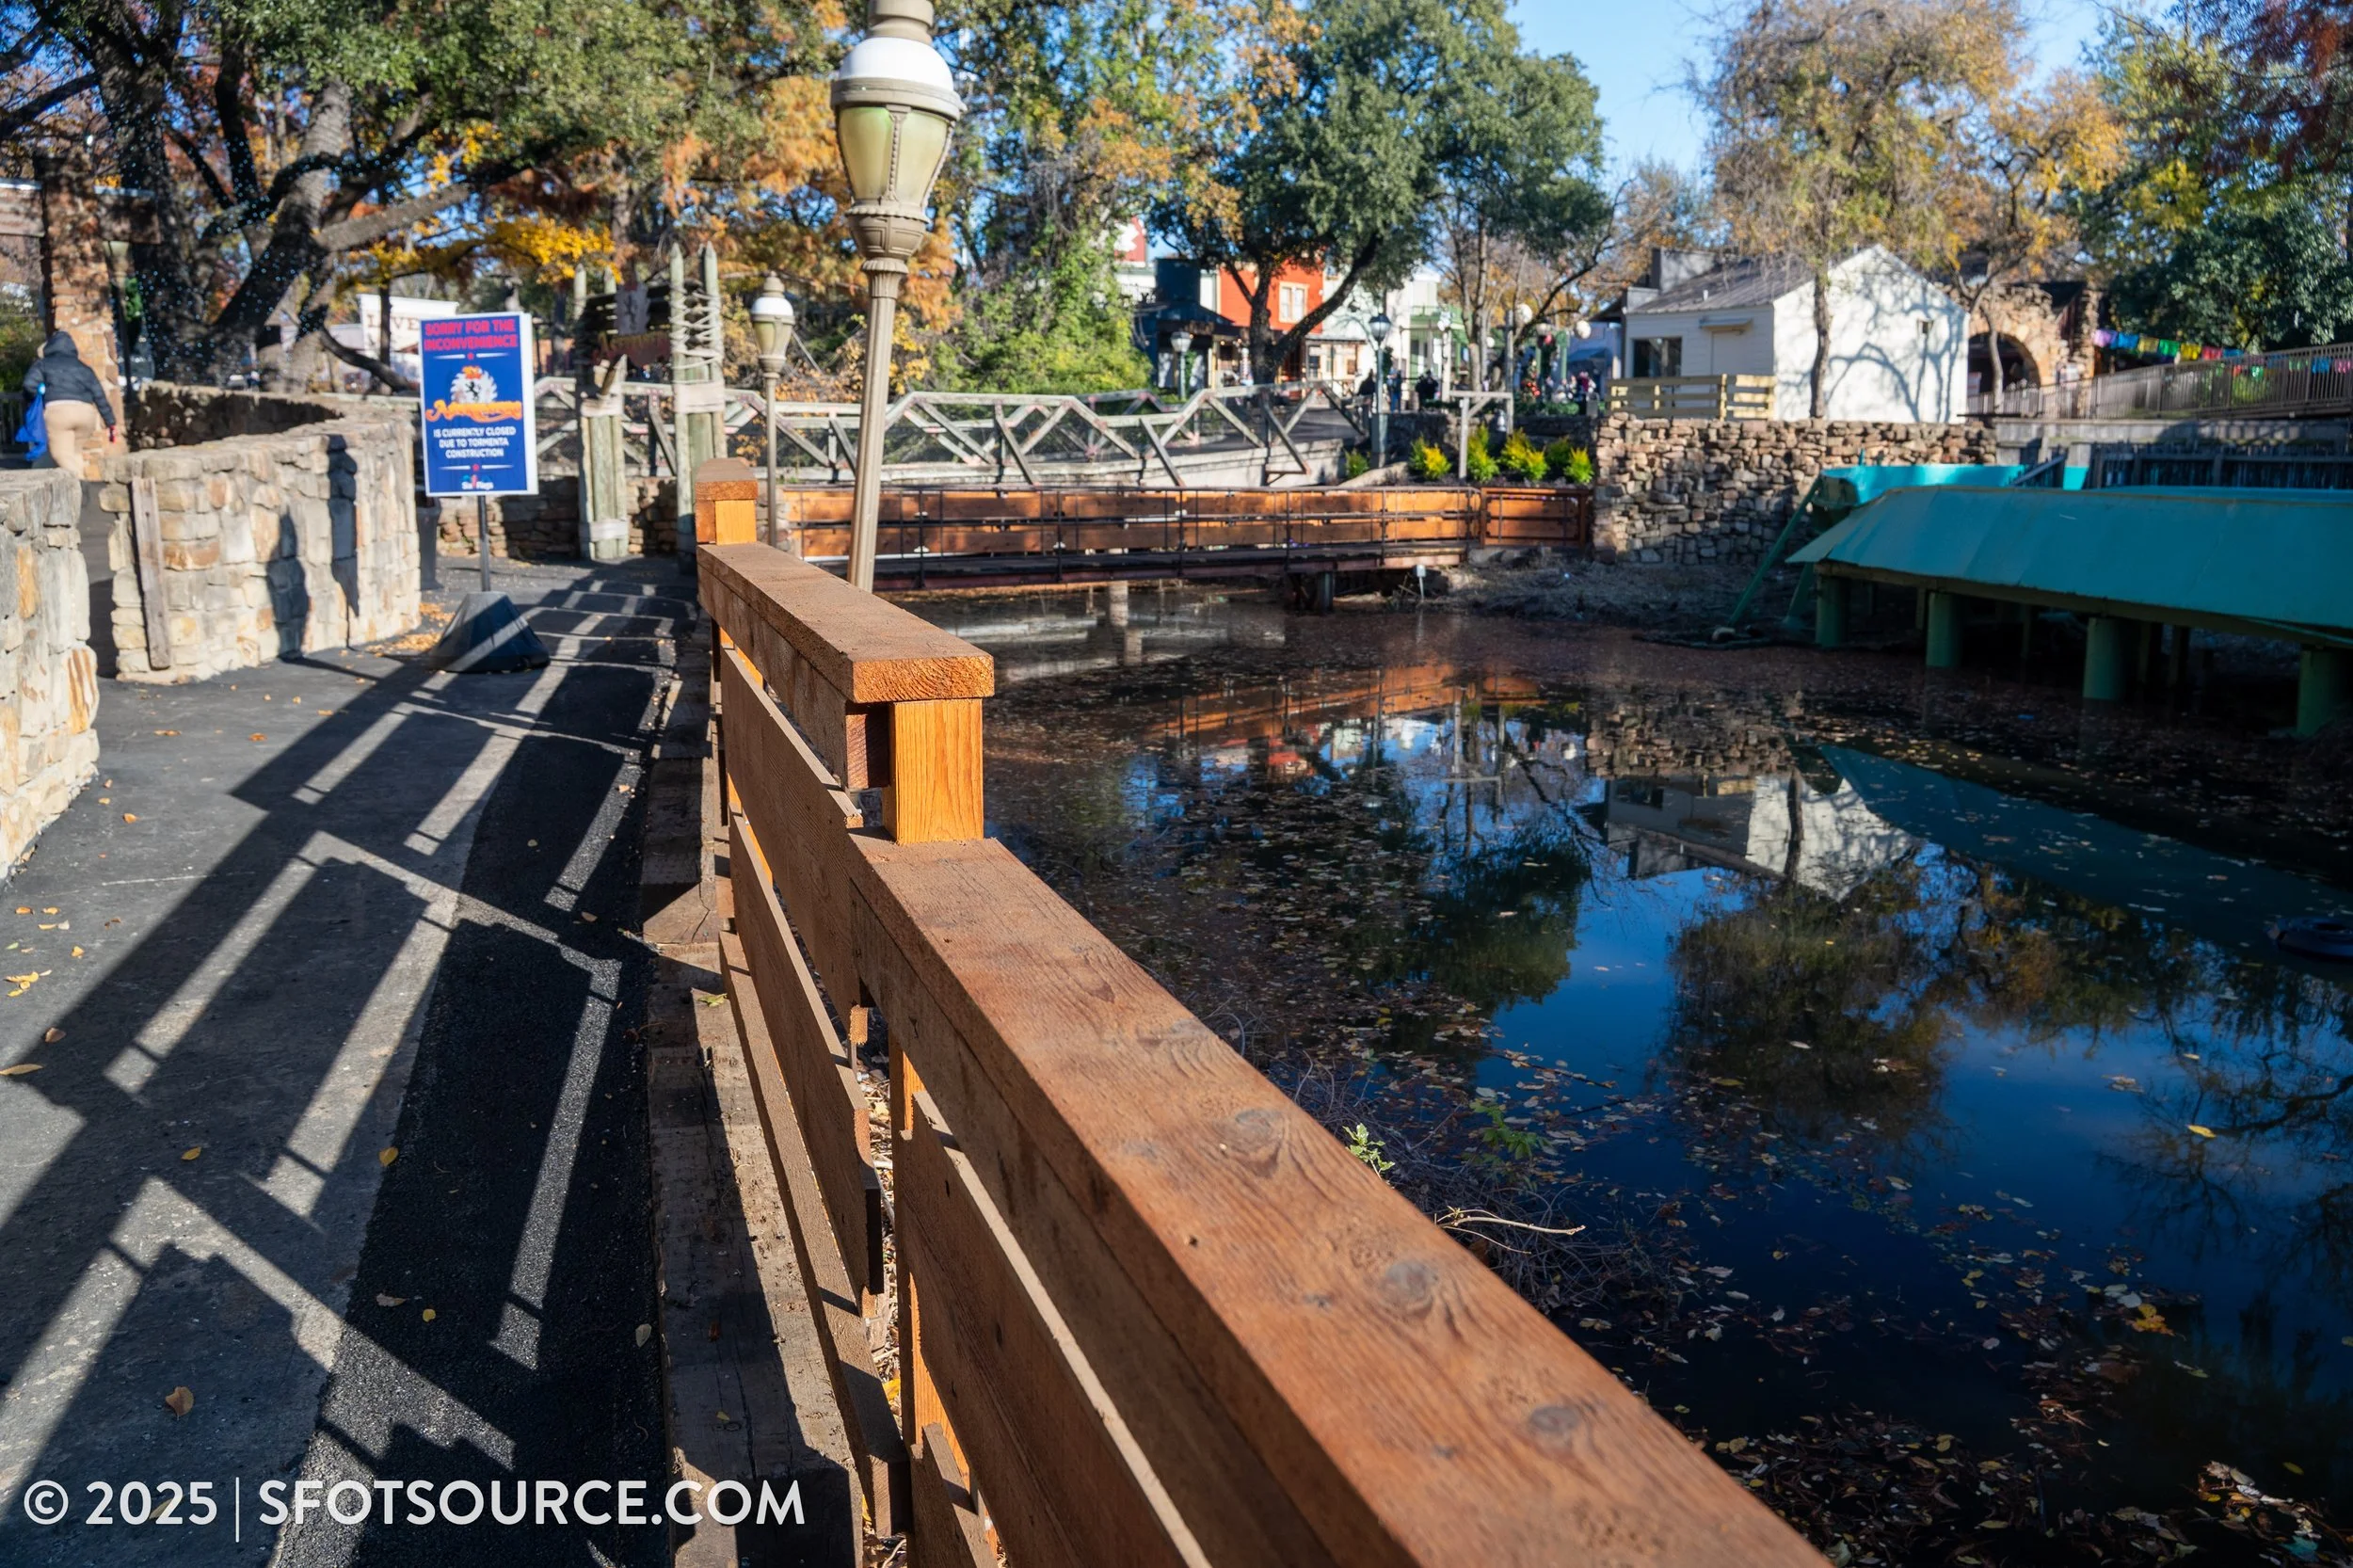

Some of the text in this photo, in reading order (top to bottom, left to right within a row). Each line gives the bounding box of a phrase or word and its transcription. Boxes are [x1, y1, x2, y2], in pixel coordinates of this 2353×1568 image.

[424, 318, 516, 336] SORRY FOR THE
[424, 334, 518, 351] INCONVENIENCE
[433, 425, 517, 439] IS CURRENTLY CLOSED
[439, 437, 510, 449] DUE TO TORMENTA
[445, 448, 504, 459] CONSTRUCTION
